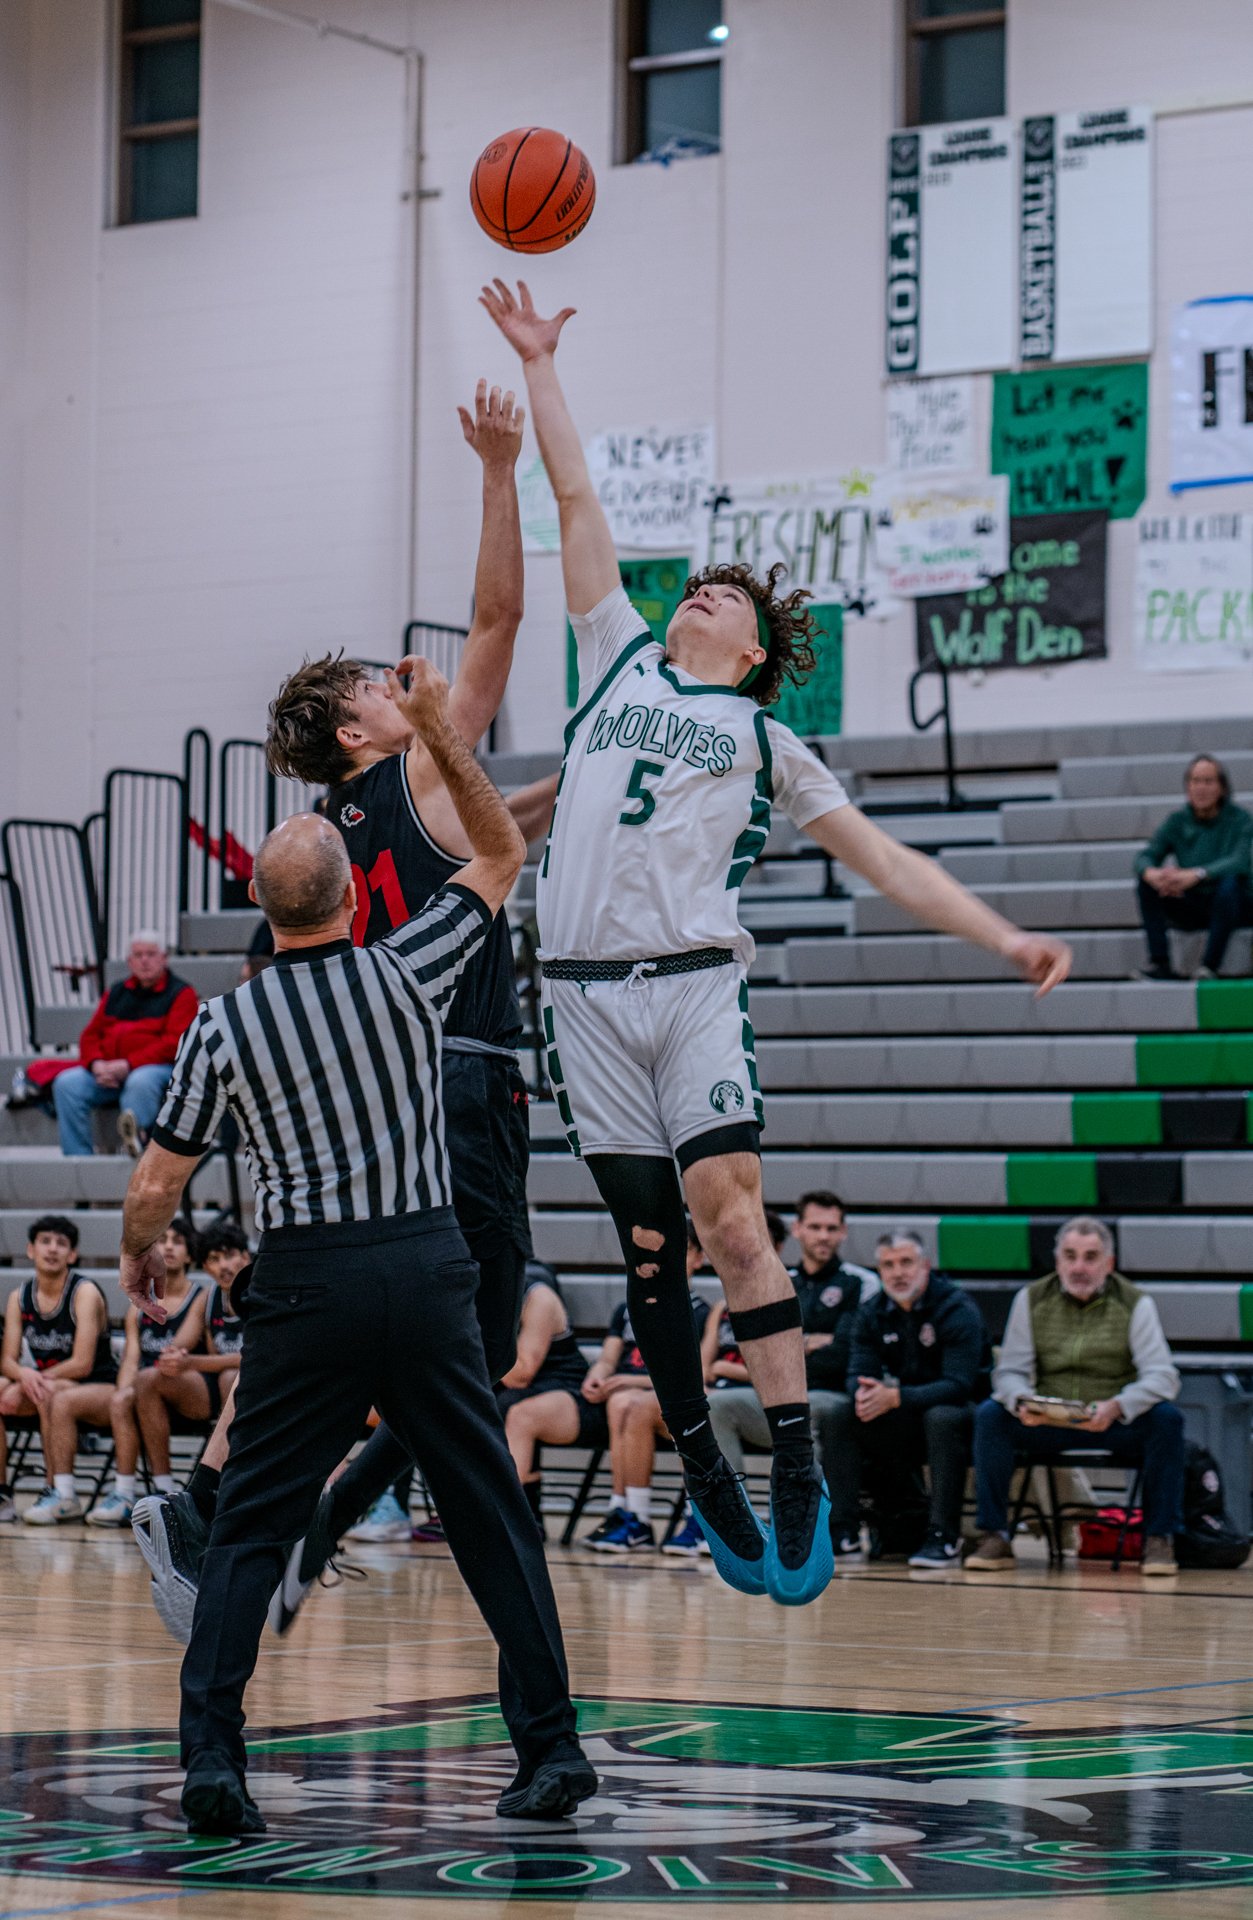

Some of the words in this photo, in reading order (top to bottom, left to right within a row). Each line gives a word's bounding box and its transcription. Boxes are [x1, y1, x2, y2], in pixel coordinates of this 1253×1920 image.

[888, 193, 919, 371] GOLF
[1021, 177, 1054, 357] BASKETBALL
[1202, 345, 1253, 427] F
[707, 504, 878, 586] FRESHMEN
[1002, 571, 1049, 603] the
[1146, 586, 1253, 644] PACK
[930, 606, 1013, 666] Wolf
[1016, 606, 1083, 664] Den
[586, 703, 736, 777] WOLVES
[618, 757, 666, 827] 5
